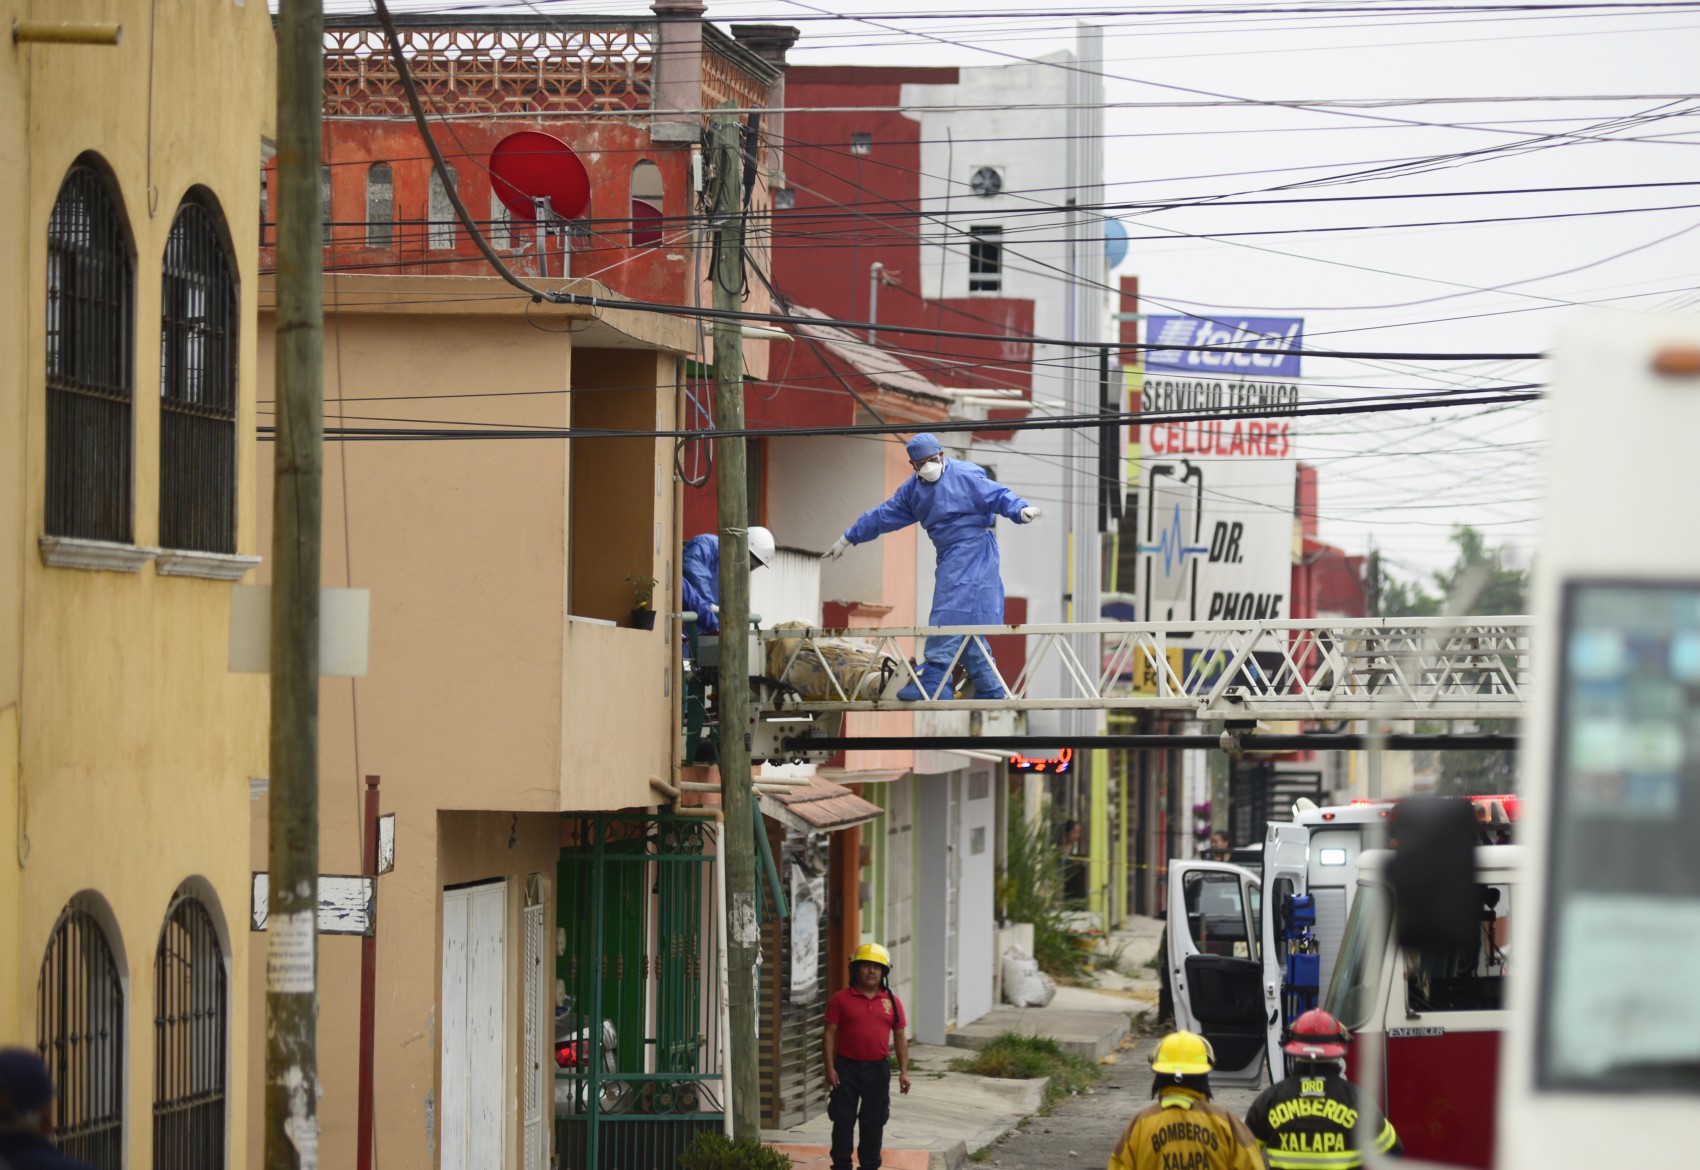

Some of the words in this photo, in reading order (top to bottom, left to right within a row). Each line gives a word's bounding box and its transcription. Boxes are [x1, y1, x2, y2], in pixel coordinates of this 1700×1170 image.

[1187, 320, 1300, 368] telcel
[1142, 380, 1222, 414] SERVICIO
[1149, 420, 1290, 458] CELULARES
[1208, 520, 1244, 564] DR.
[1207, 592, 1283, 634] PHONE
[1268, 1098, 1358, 1129] BOMBEROS
[1151, 1121, 1219, 1153] BOMBEROS
[1278, 1132, 1345, 1152] XALAPA
[1163, 1151, 1211, 1170] XALAPA
